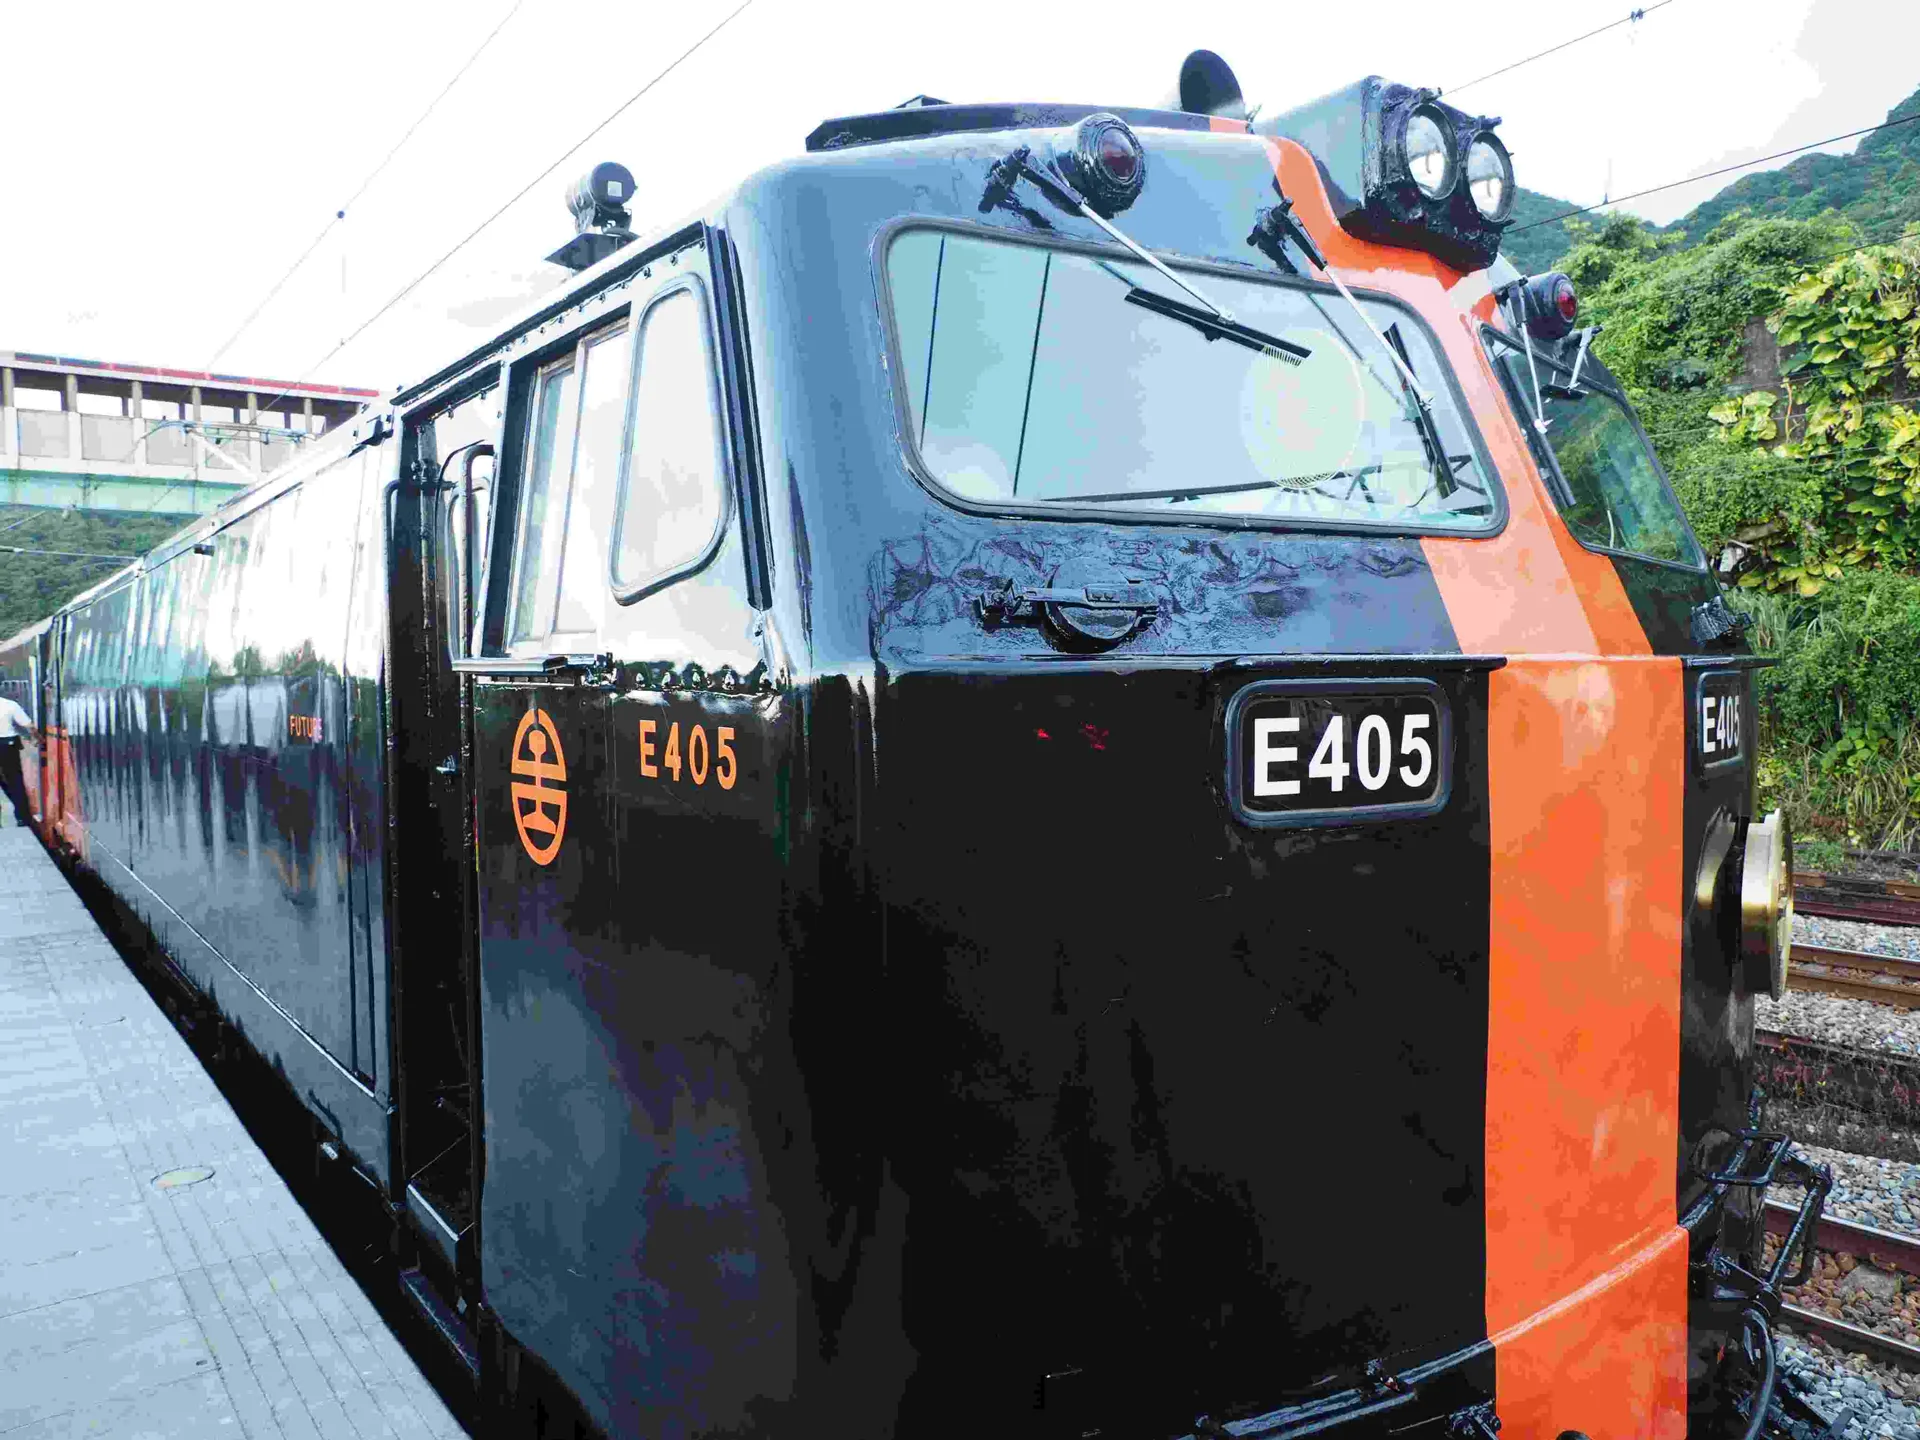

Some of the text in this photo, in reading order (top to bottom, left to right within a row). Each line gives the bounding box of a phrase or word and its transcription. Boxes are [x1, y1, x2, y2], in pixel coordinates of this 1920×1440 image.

[639, 719, 737, 790] E405
[1254, 714, 1432, 796] E405
[1702, 695, 1740, 753] E405
